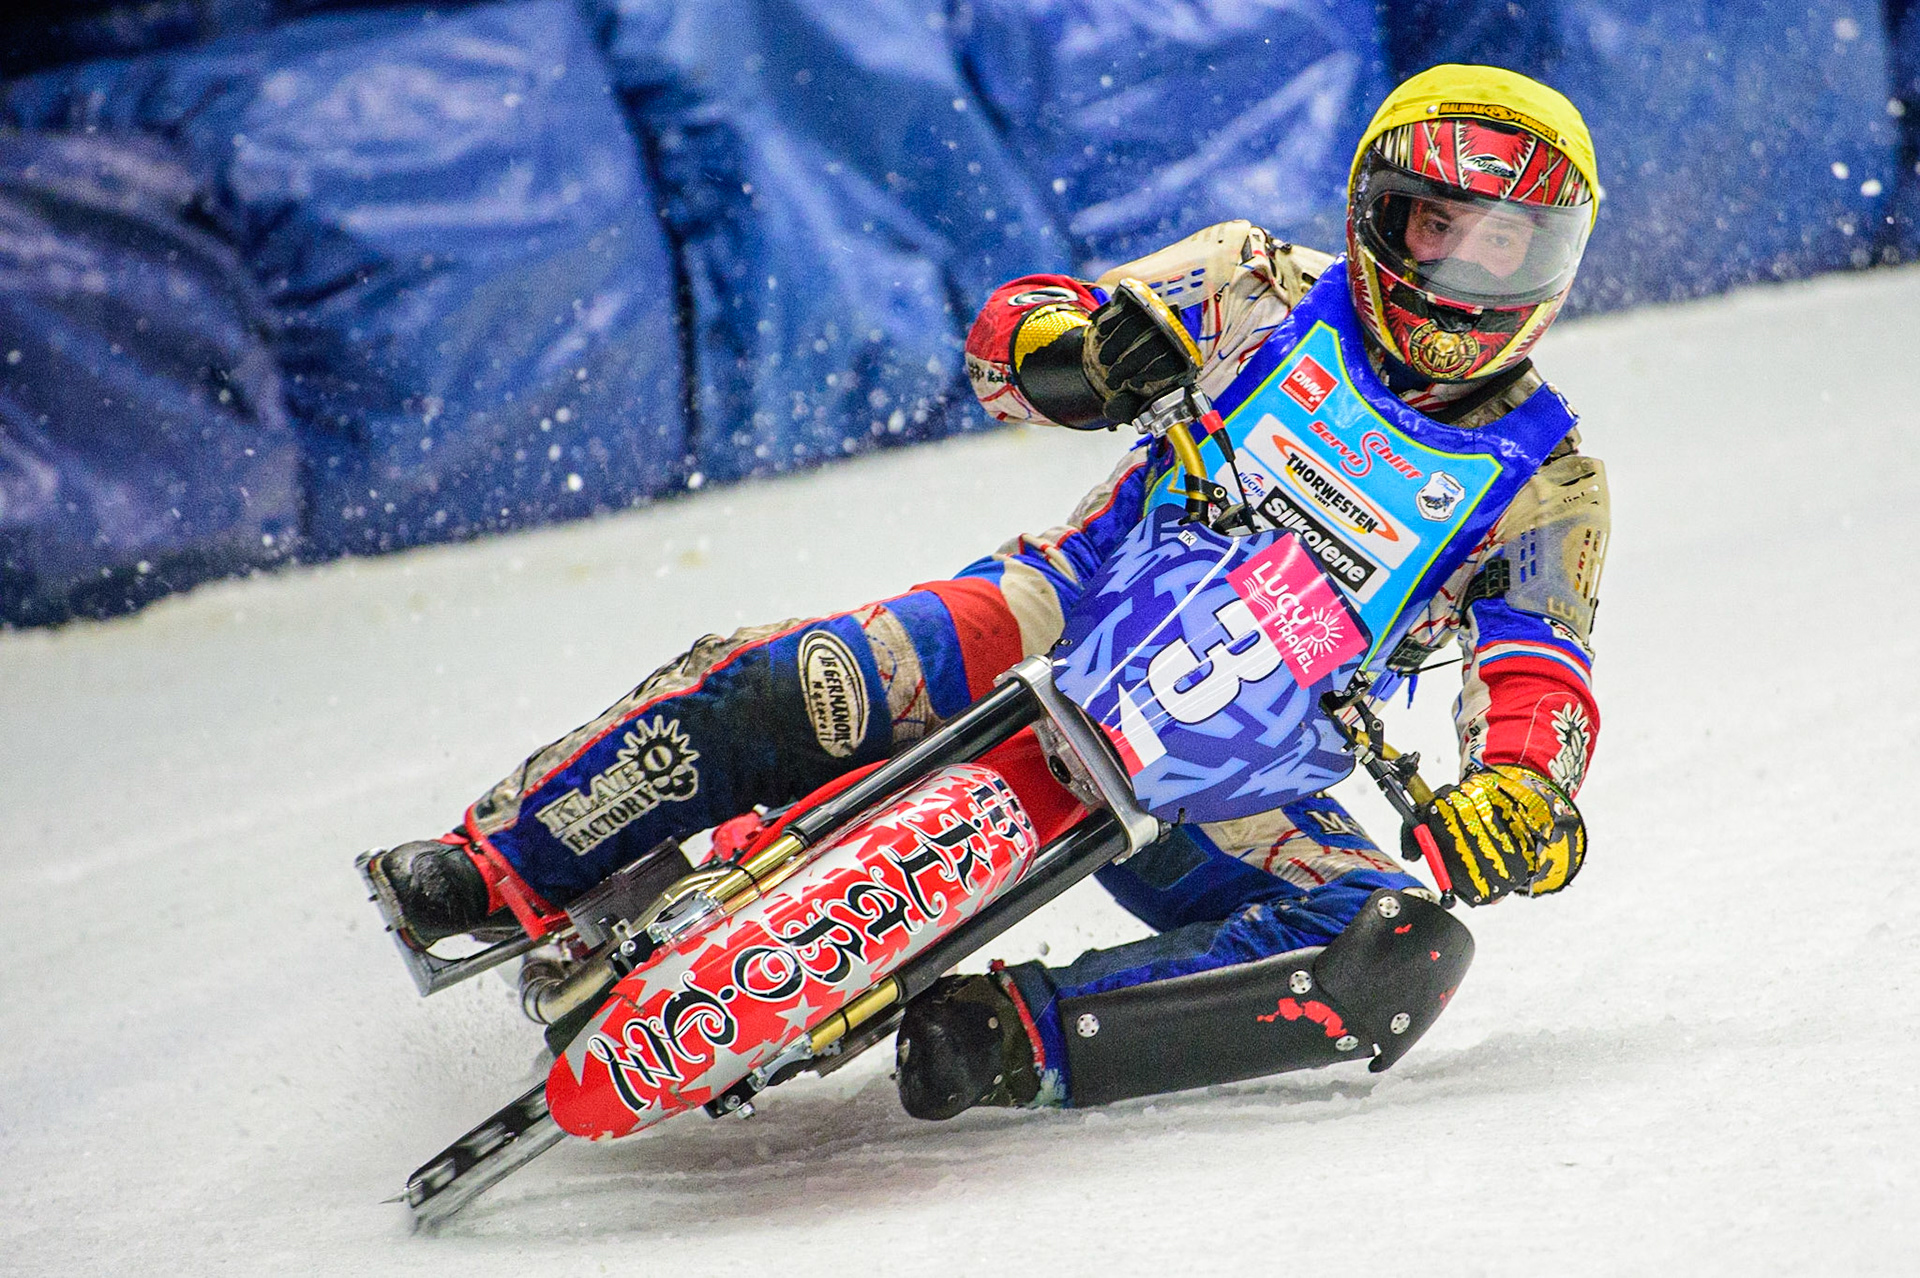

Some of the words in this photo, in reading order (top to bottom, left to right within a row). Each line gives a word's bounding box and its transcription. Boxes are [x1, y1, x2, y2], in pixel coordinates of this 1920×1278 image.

[1290, 369, 1326, 398] DMV
[1238, 471, 1265, 499] FUCHS
[1286, 452, 1379, 534] THORWESTEN
[1181, 530, 1195, 545] TK
[1264, 496, 1367, 584] Silkolene
[1252, 560, 1312, 627] LUCY
[1147, 599, 1283, 725] 3
[1276, 614, 1314, 675] TRAVEL
[546, 745, 674, 832] KLABO
[567, 783, 658, 852] FACTORY
